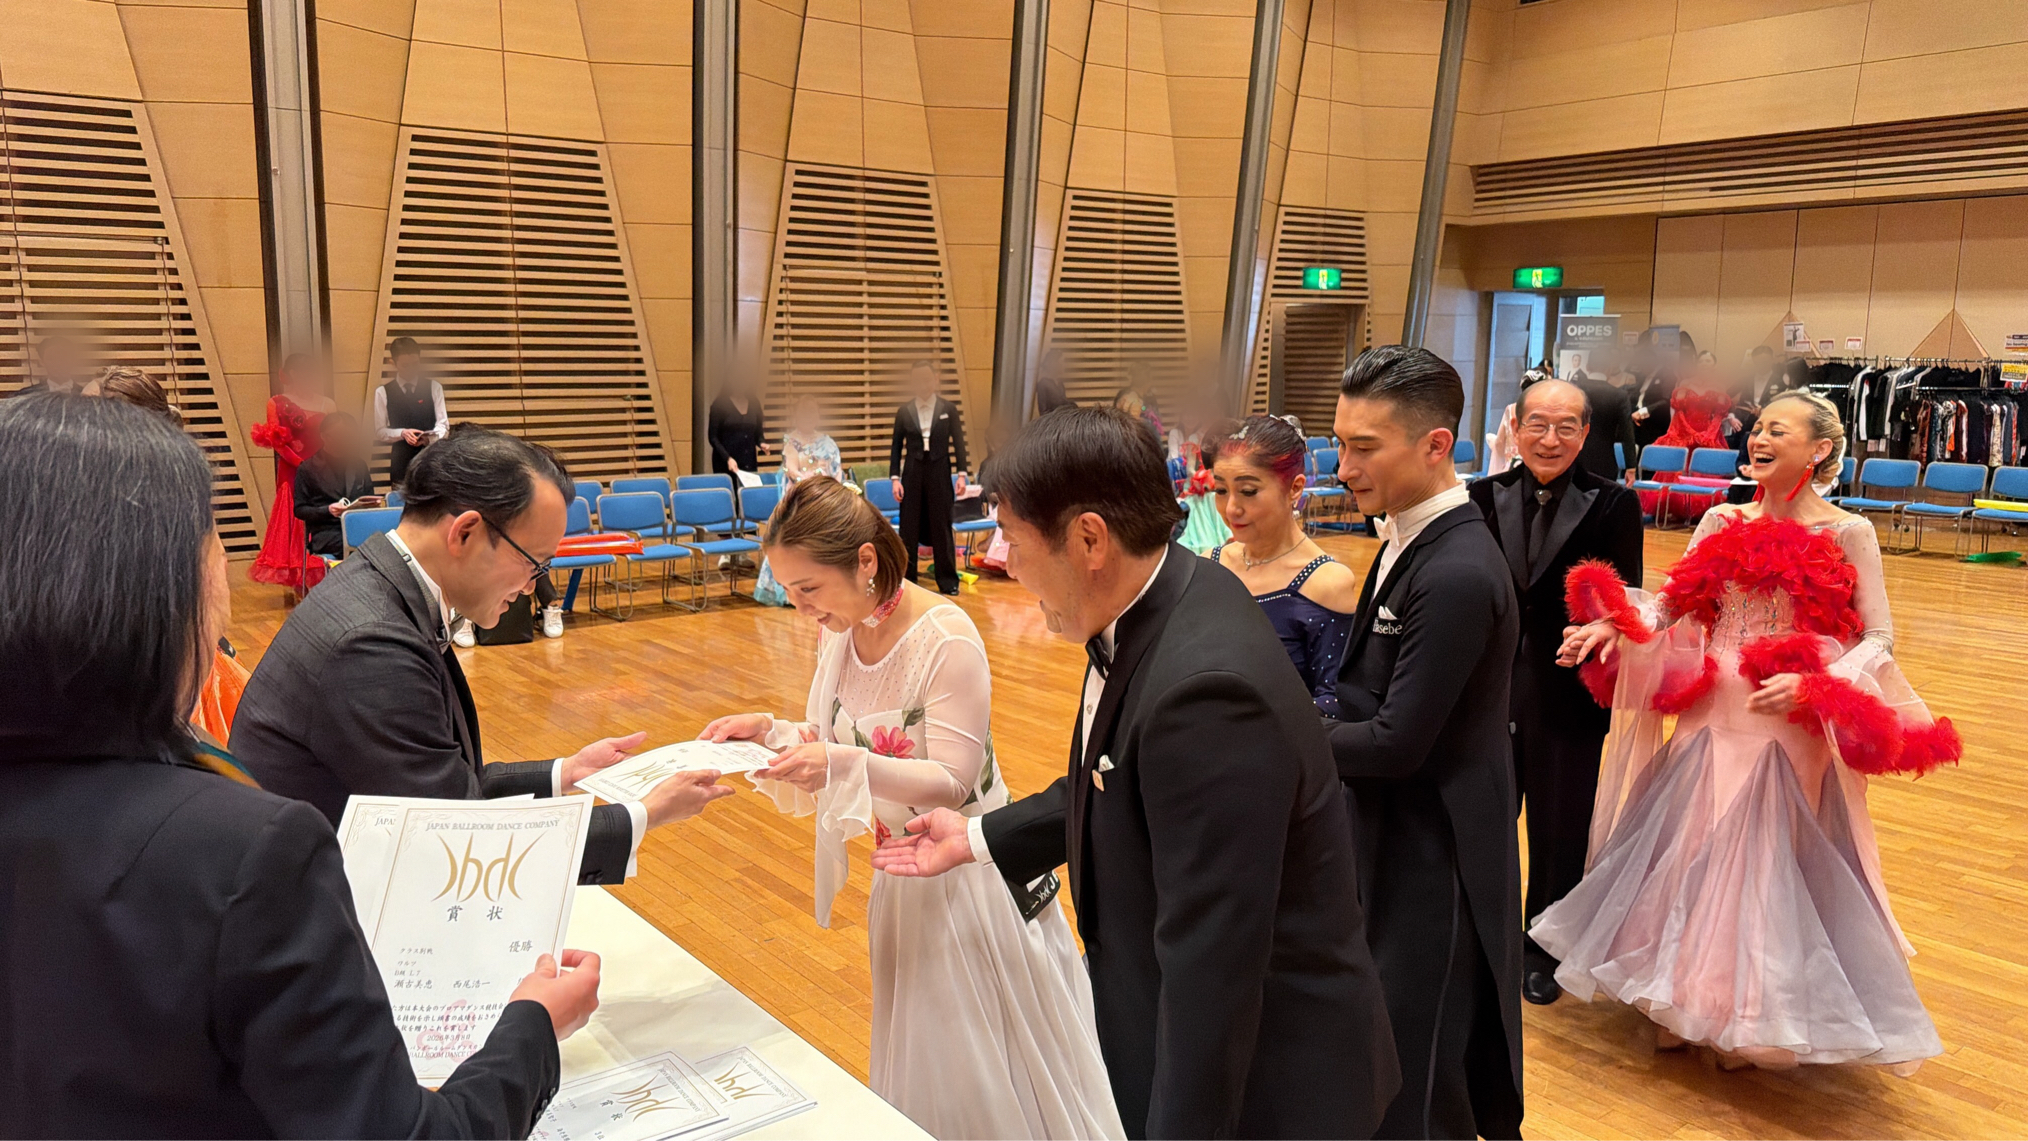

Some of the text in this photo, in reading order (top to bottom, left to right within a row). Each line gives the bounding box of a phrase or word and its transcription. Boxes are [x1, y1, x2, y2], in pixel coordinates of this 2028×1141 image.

[1567, 325, 1612, 336] OPPES
[426, 822, 450, 831] JAPAN
[496, 822, 523, 830] DANCE
[524, 819, 560, 829] COMPANY
[509, 940, 533, 953] 優勝
